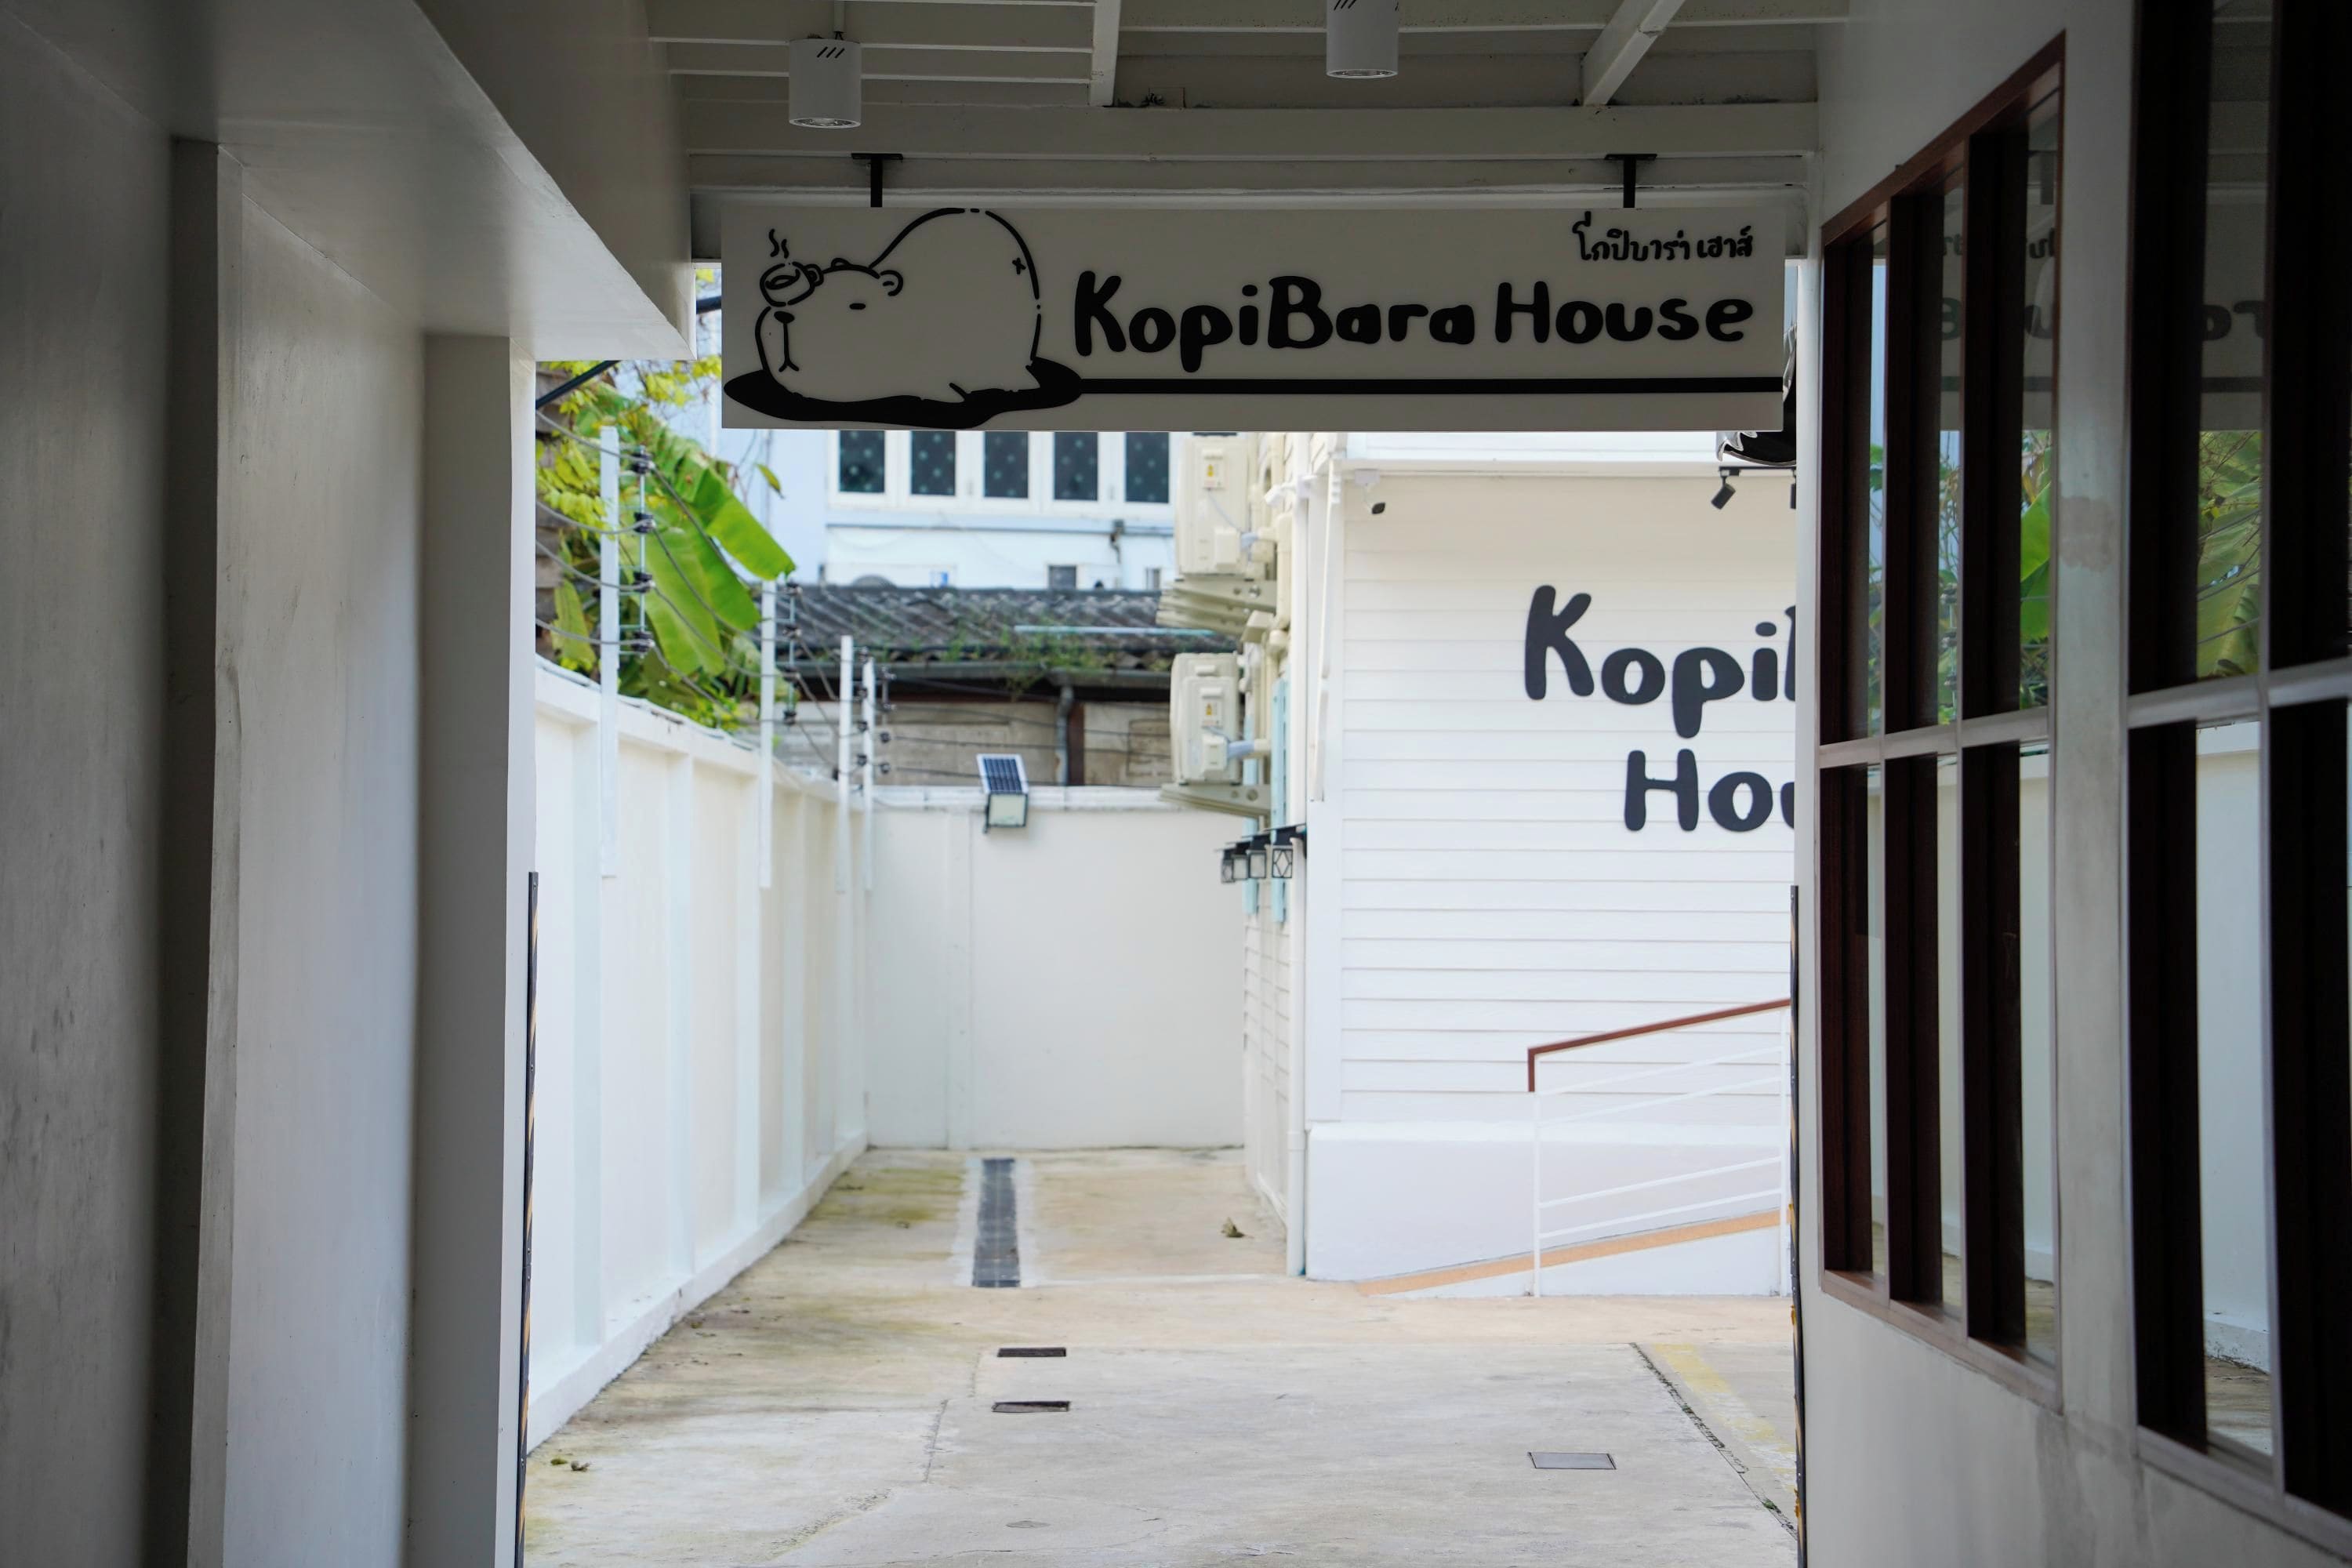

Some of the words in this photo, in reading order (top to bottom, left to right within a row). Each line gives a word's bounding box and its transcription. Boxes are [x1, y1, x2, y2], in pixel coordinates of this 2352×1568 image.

[1074, 270, 1475, 373] KopiBara
[1494, 281, 1754, 344] House
[1525, 585, 1795, 739] Kopi
[1624, 749, 1794, 832] Ho
